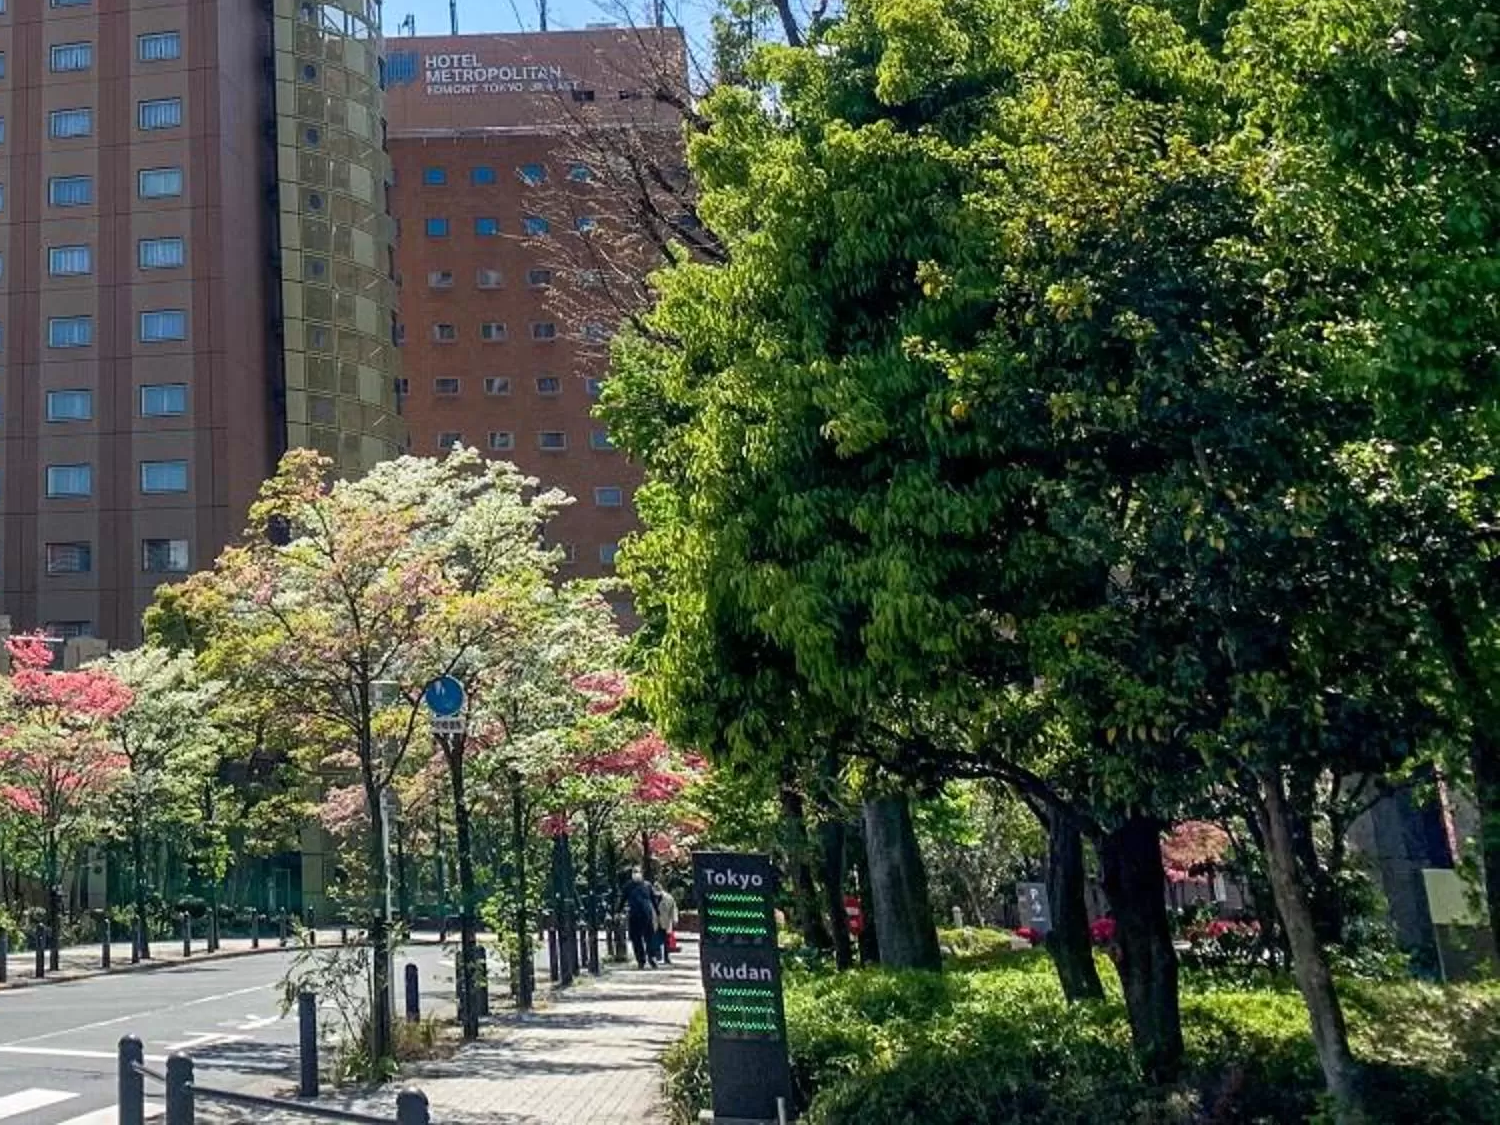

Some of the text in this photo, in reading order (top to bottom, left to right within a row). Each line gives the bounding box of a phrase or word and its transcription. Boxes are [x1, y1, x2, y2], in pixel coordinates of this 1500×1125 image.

[425, 54, 482, 69] HOTEL
[425, 66, 562, 84] METROPOLITAN
[704, 869, 763, 890] Tokyo
[710, 962, 773, 982] Kudan
